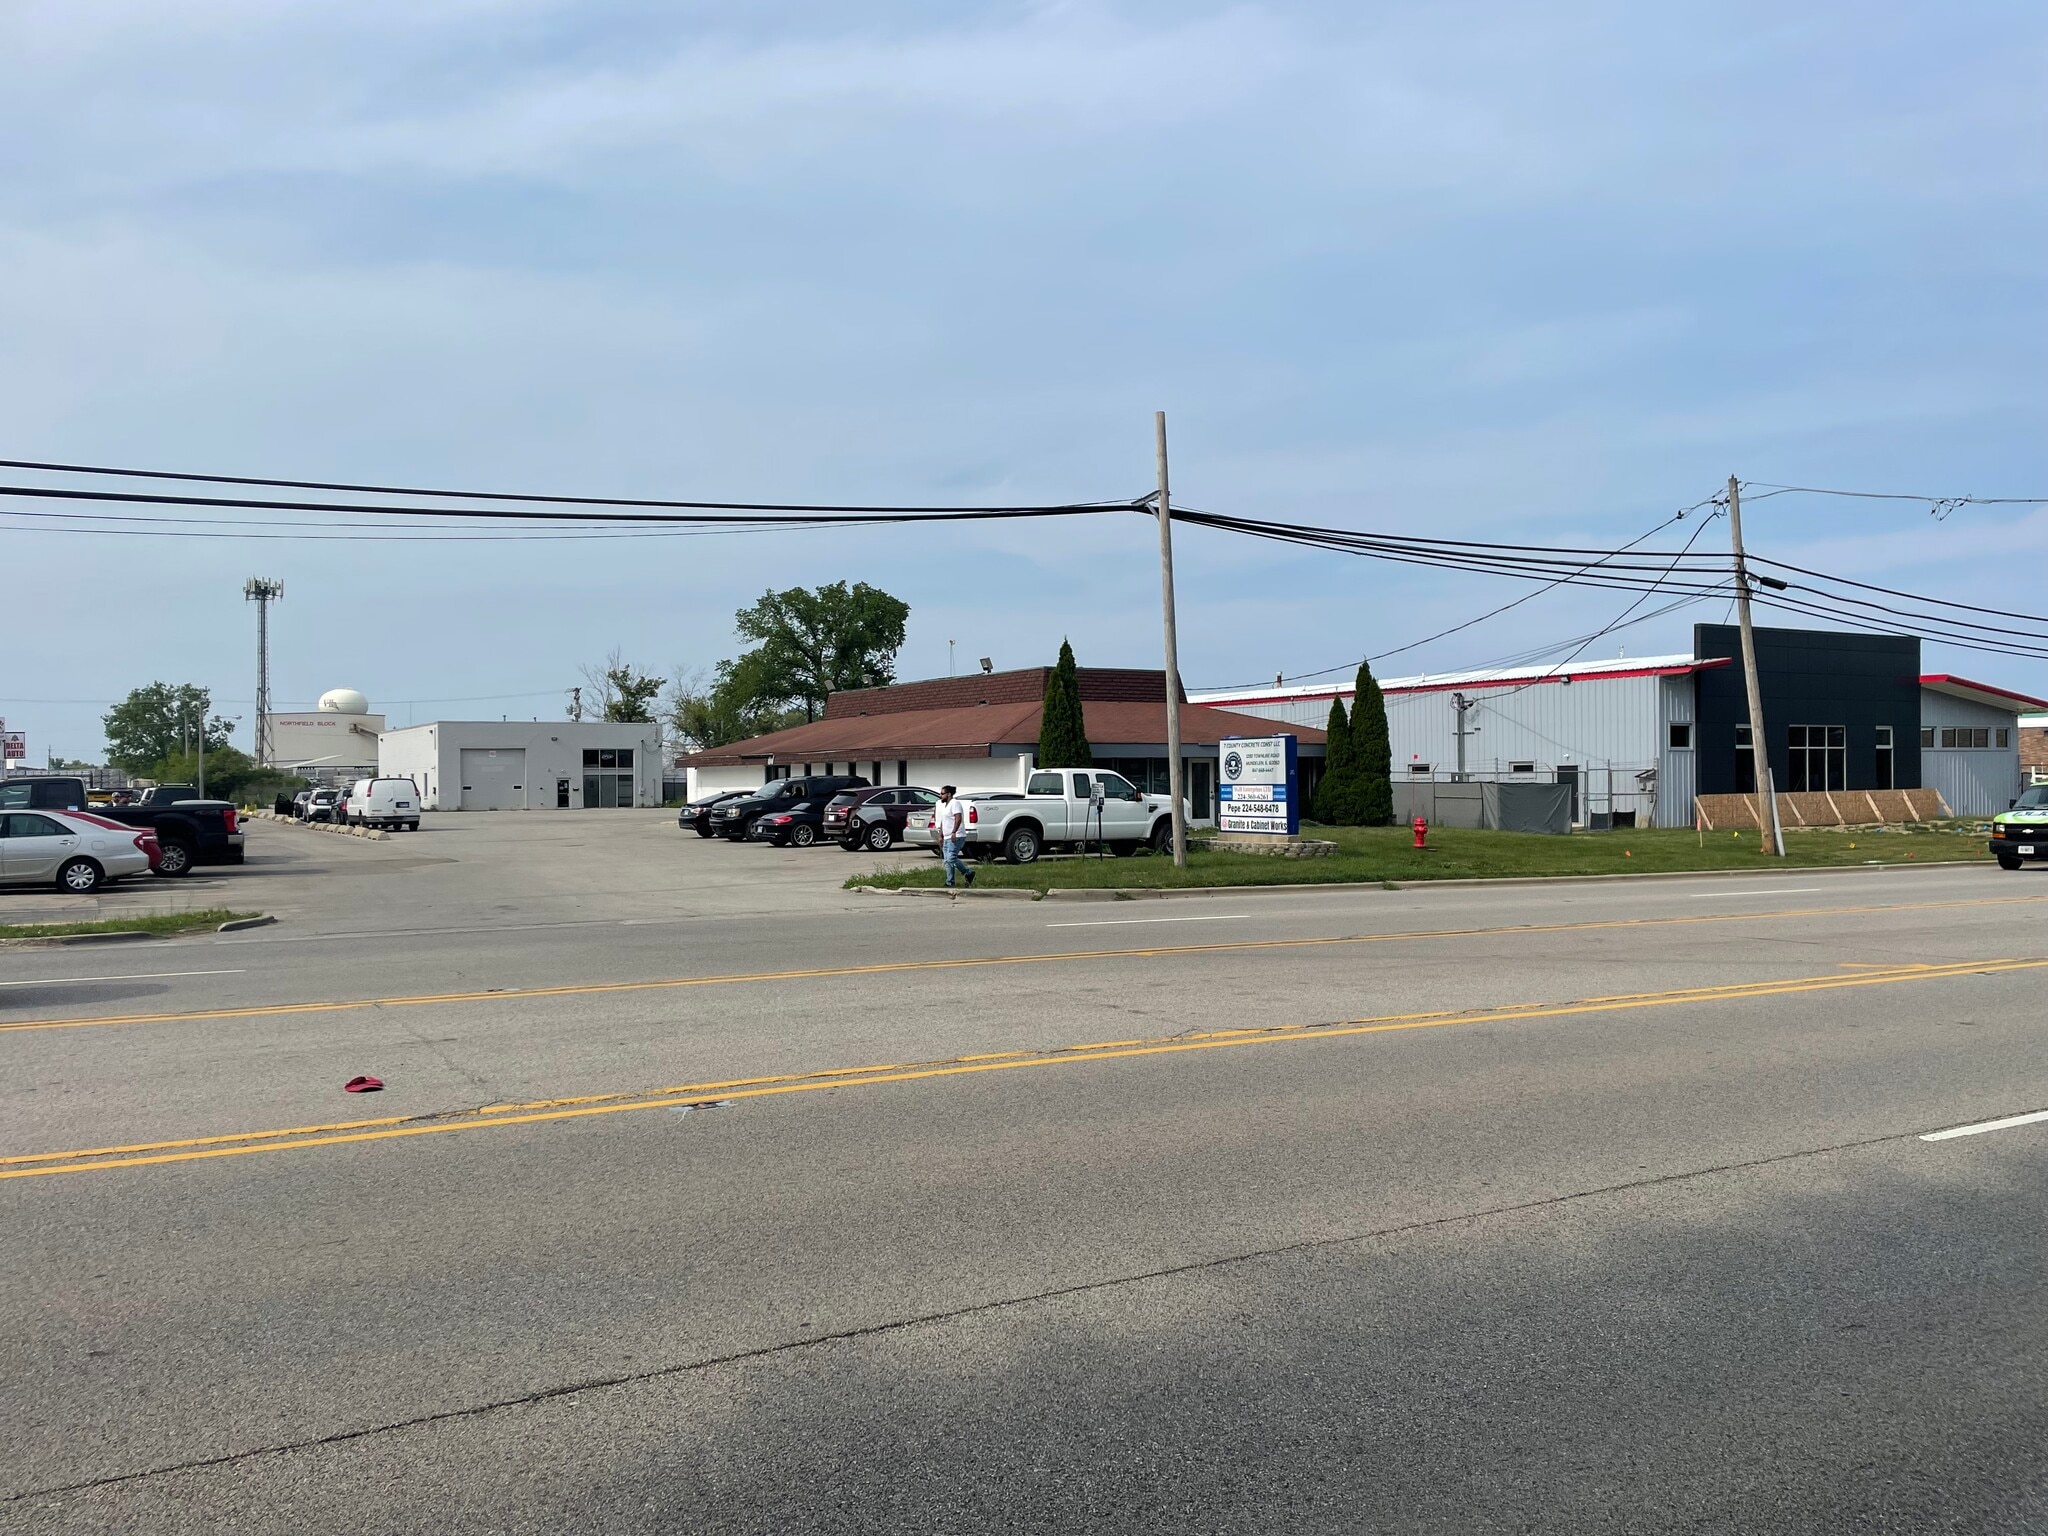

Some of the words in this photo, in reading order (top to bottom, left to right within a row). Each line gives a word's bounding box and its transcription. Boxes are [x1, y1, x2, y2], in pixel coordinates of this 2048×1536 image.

[1228, 804, 1241, 814] Pepe
[1242, 804, 1279, 813] 224-548-6478
[1228, 819, 1245, 829] Granite
[1251, 820, 1269, 830] Cabinet
[1270, 821, 1287, 830] Works
